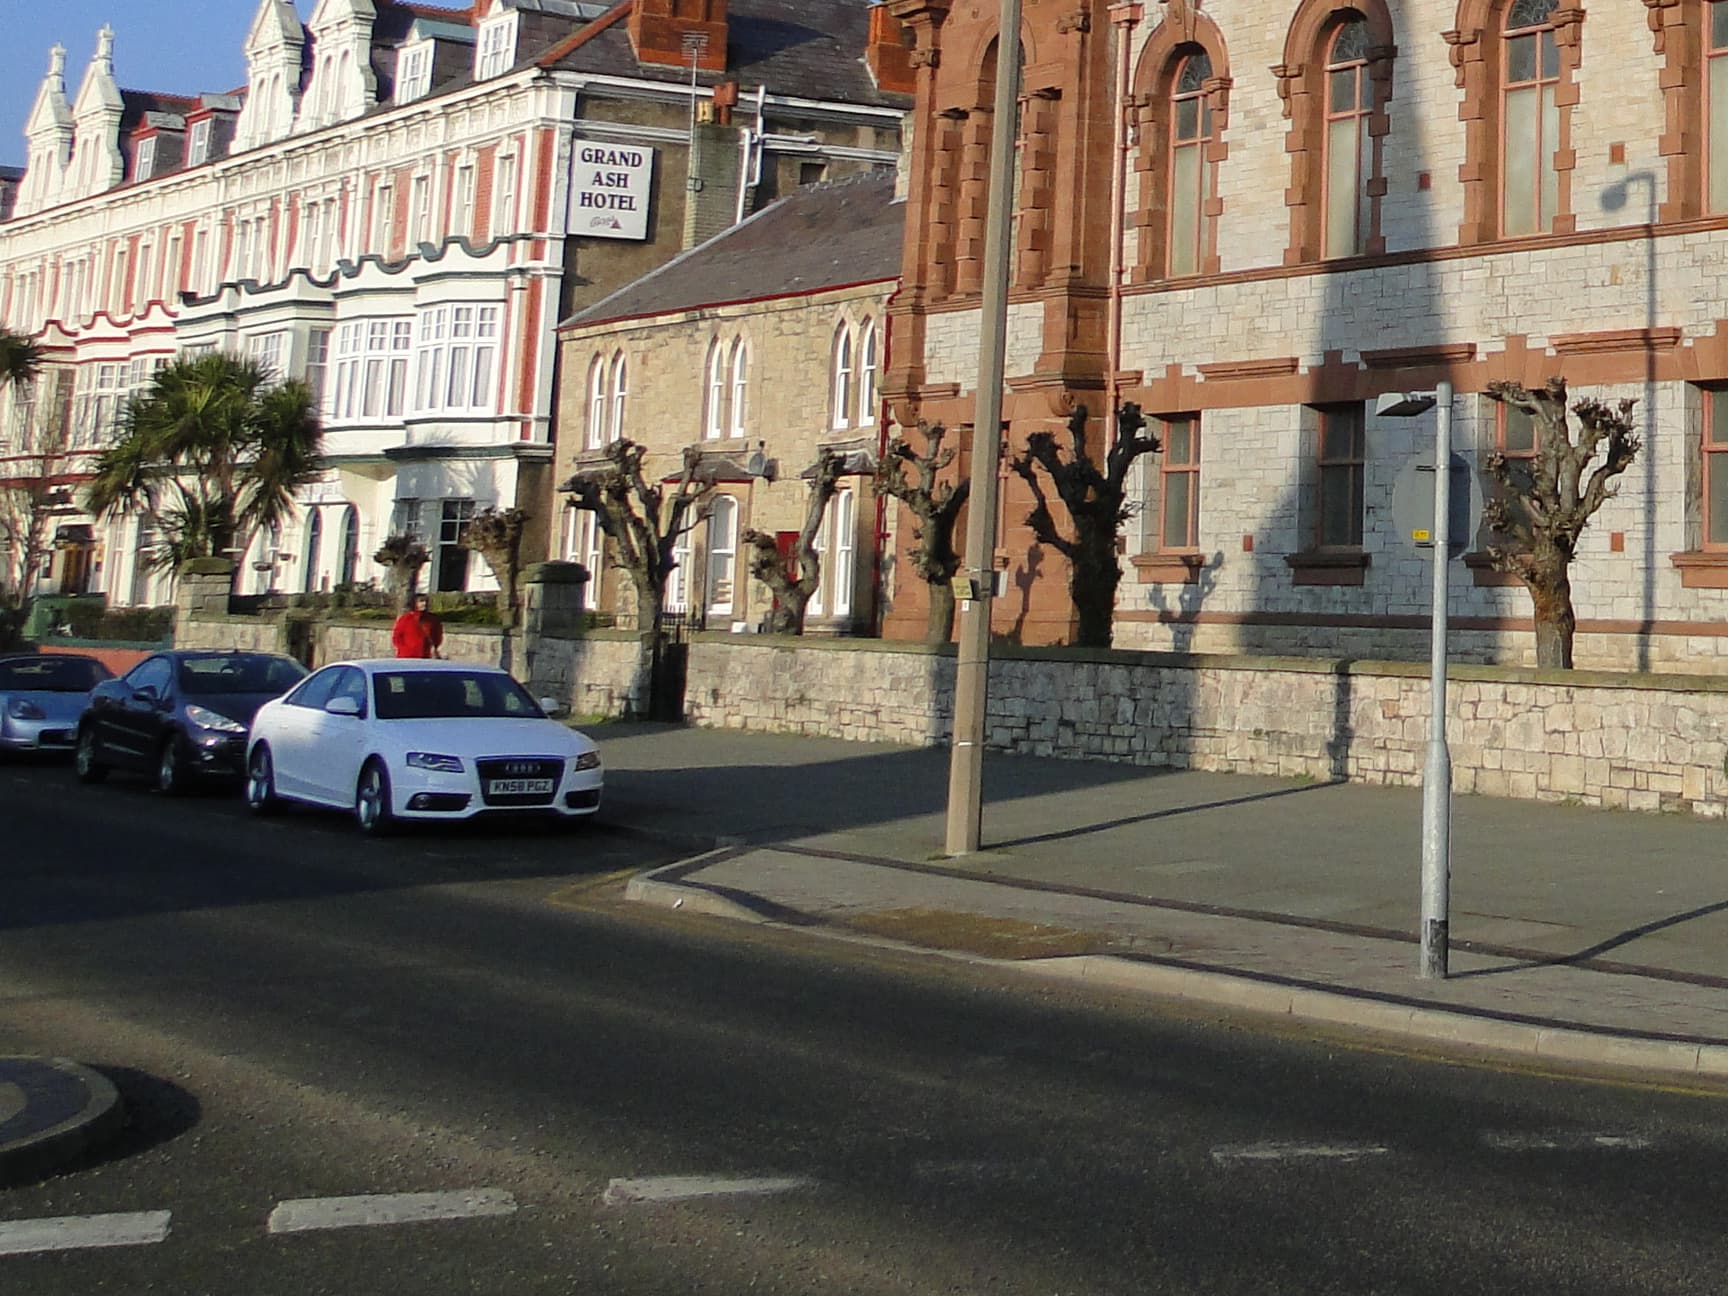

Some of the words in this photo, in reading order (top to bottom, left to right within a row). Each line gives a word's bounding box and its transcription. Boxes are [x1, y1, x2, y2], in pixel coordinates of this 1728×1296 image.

[581, 148, 643, 167] GRAND
[592, 171, 629, 188] ASH
[580, 192, 637, 211] HOTEL
[527, 780, 550, 791] PGZ
